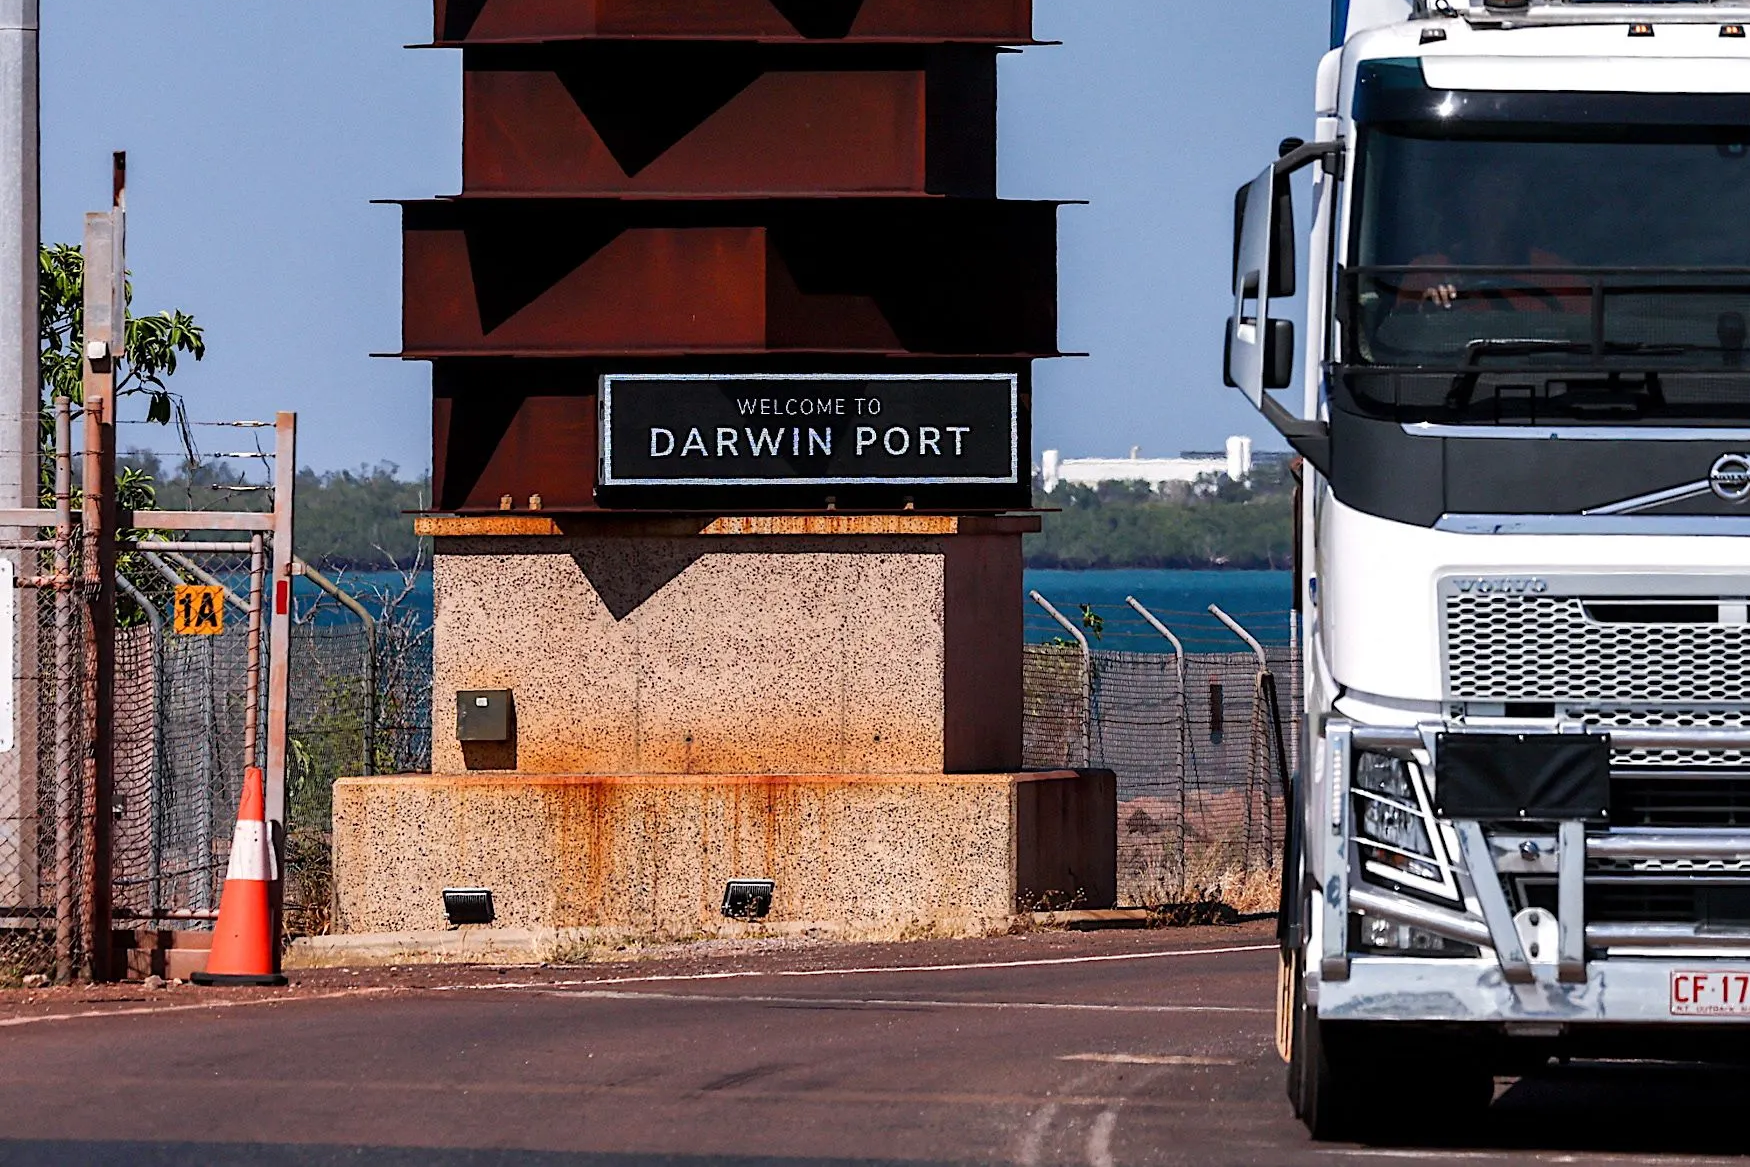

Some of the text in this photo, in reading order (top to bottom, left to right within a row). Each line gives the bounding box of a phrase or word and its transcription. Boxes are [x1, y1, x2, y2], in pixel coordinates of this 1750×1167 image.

[737, 398, 881, 416] WELCOME TO
[649, 426, 971, 458] DARWIN PORT
[178, 592, 218, 628] 1A
